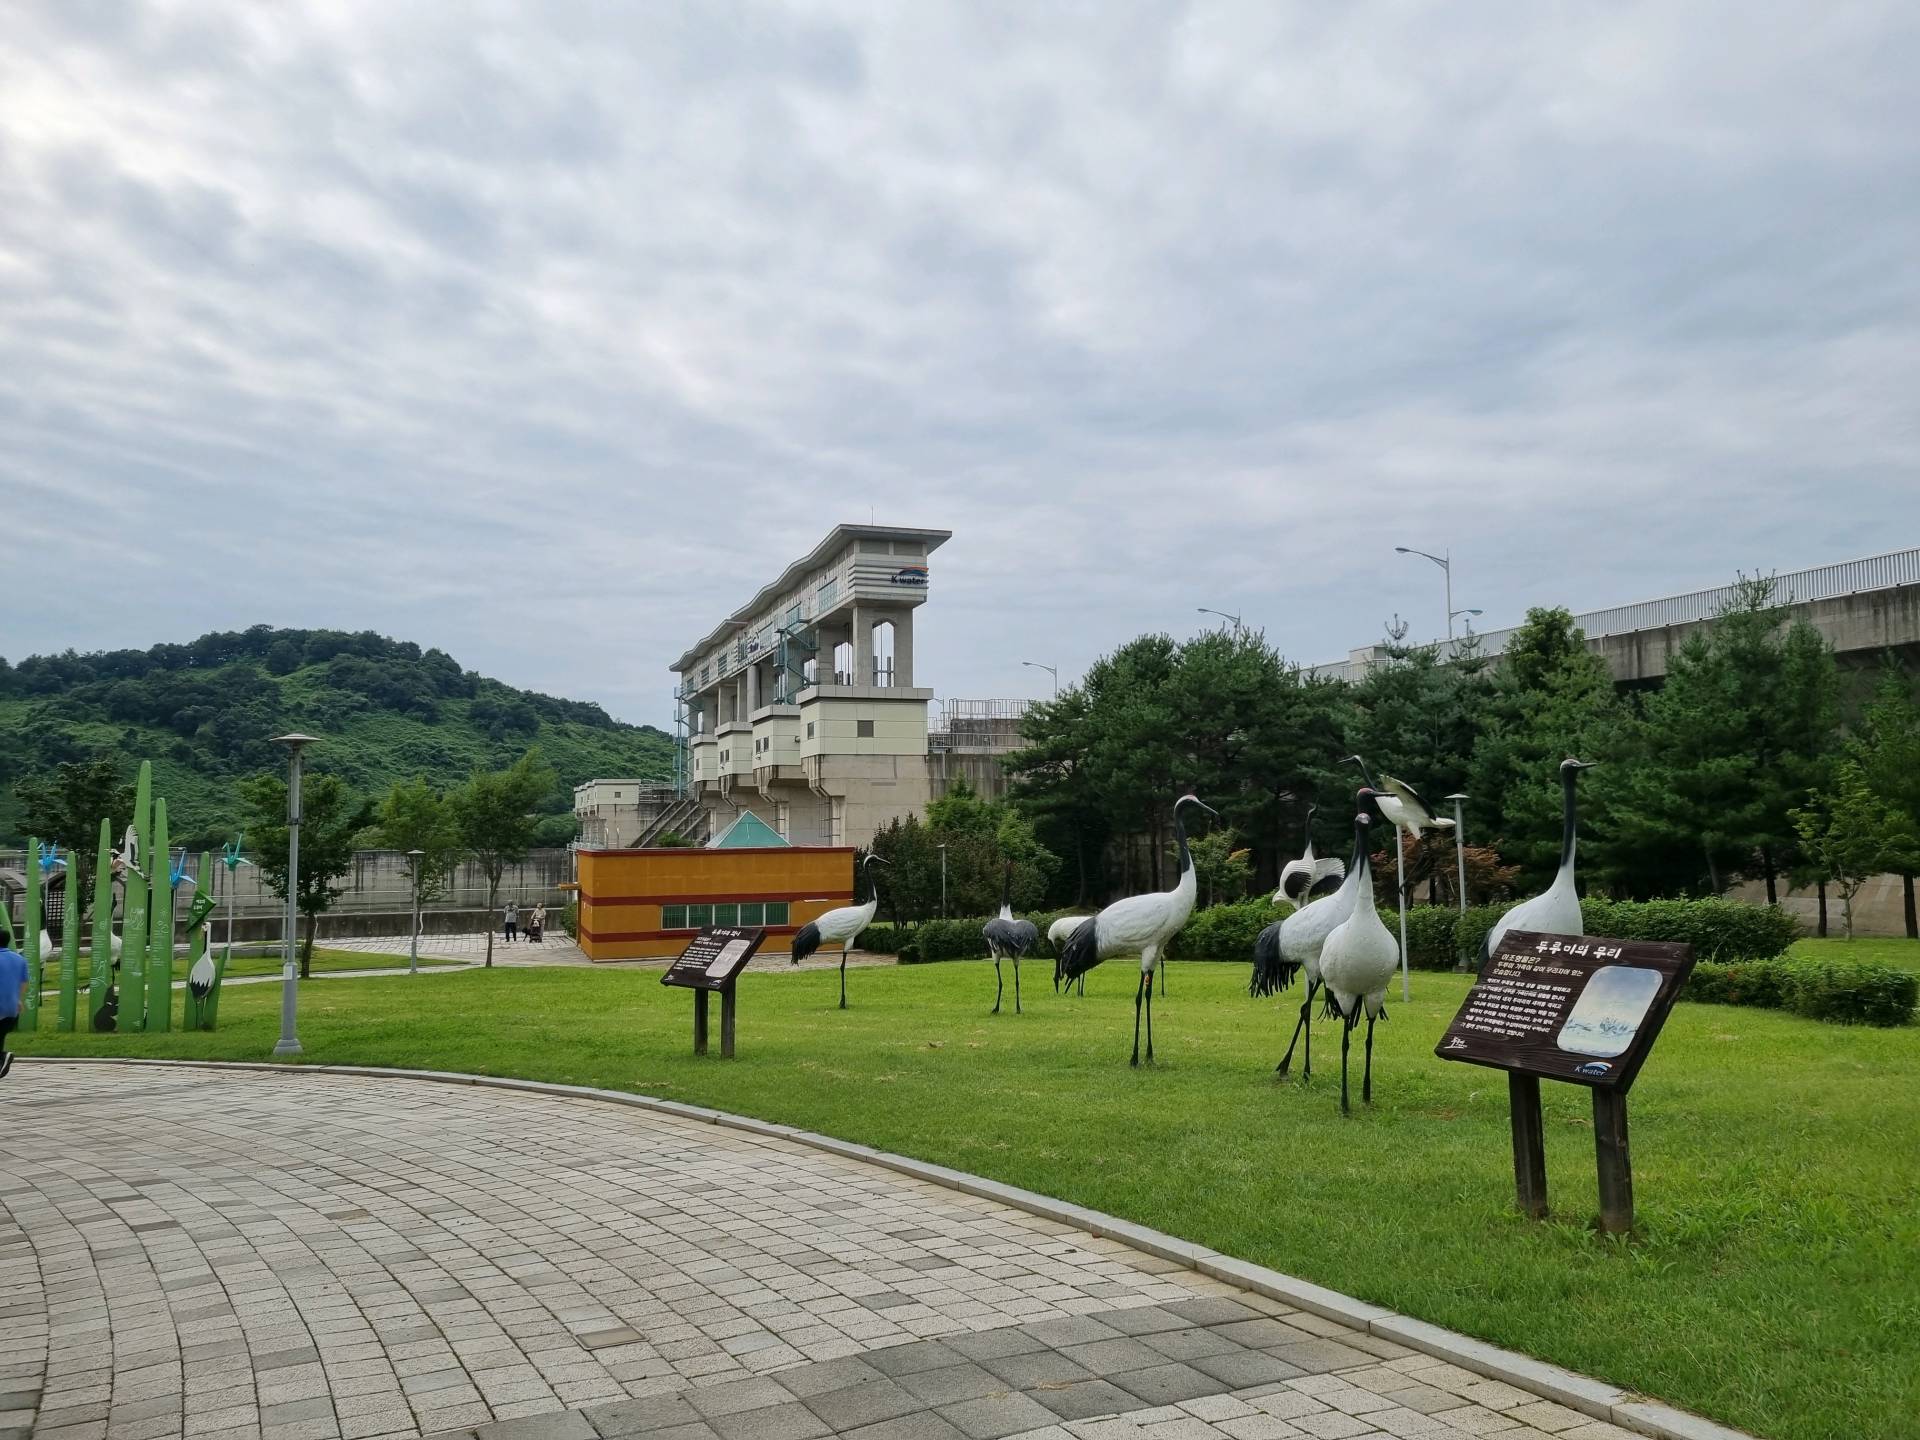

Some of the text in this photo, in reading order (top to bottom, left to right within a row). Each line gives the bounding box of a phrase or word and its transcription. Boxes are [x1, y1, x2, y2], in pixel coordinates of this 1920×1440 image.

[1536, 941, 1622, 959] 두루미의 무리
[1583, 1068, 1606, 1077] water
